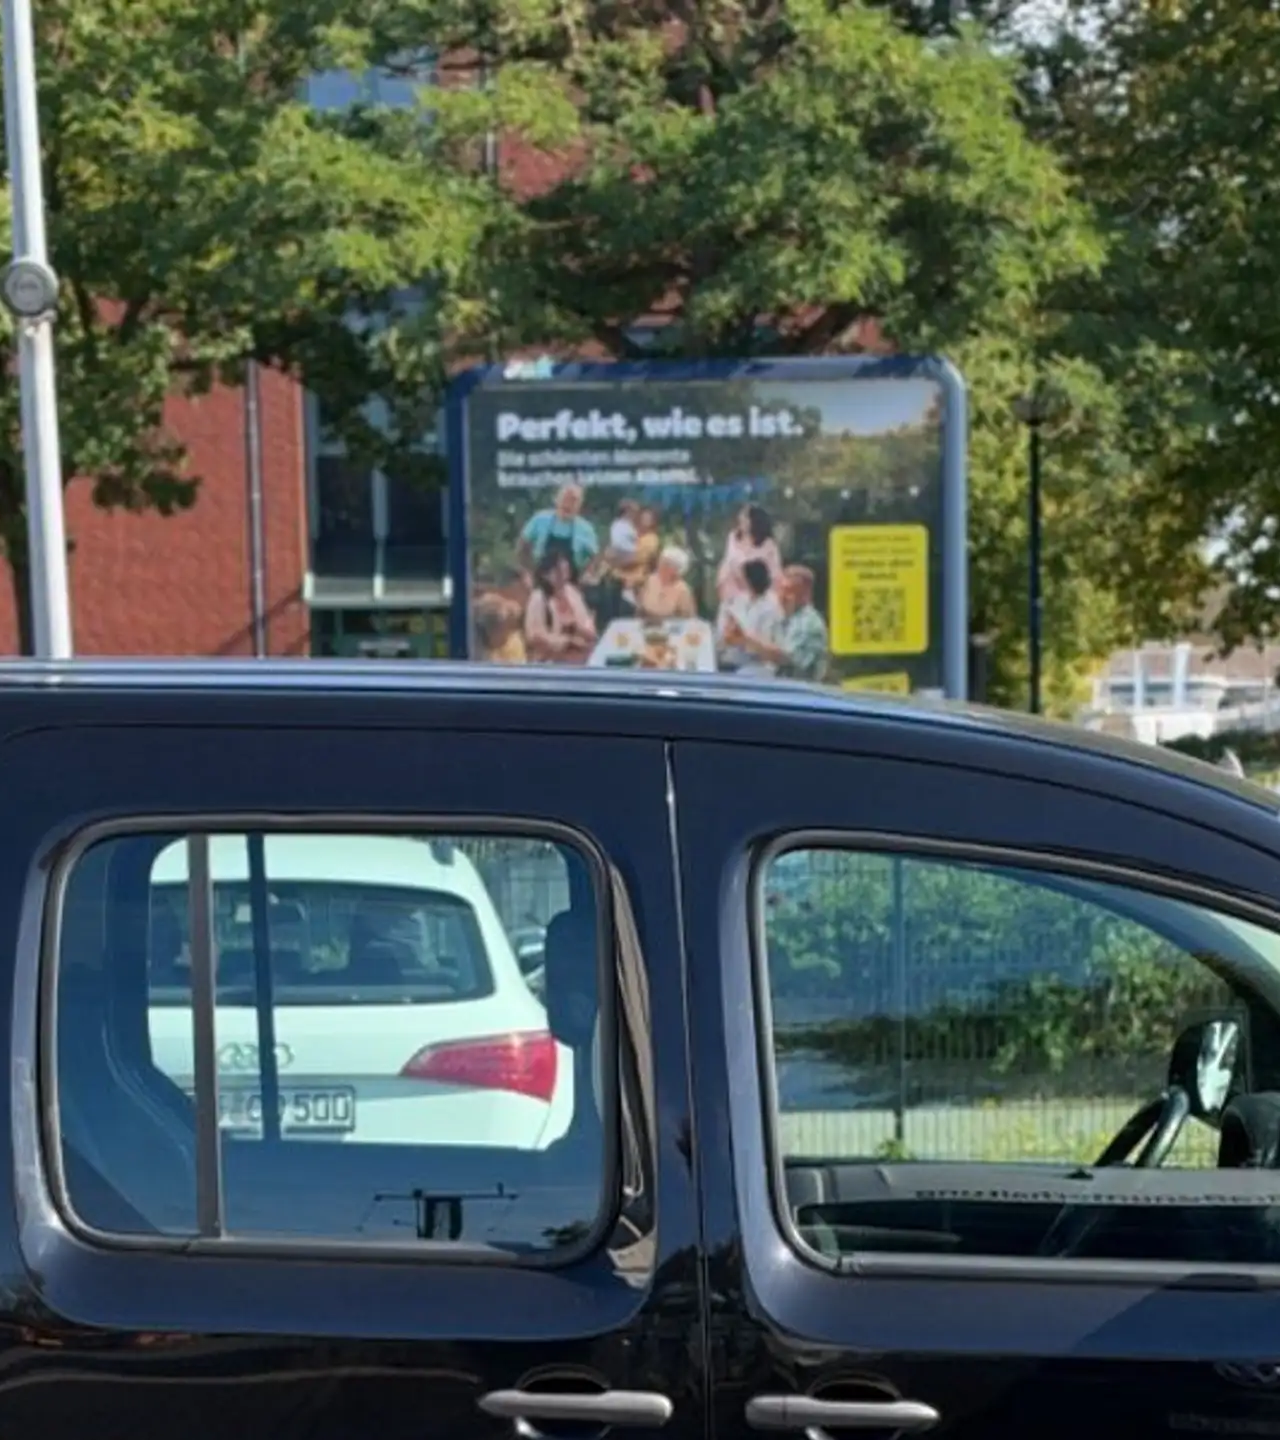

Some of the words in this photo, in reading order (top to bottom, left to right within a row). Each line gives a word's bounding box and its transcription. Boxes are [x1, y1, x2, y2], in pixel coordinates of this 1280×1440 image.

[496, 408, 638, 444] Perfekt,
[641, 406, 703, 438] wie
[706, 413, 743, 438] es
[748, 405, 804, 437] ist.
[293, 1092, 350, 1122] 500
